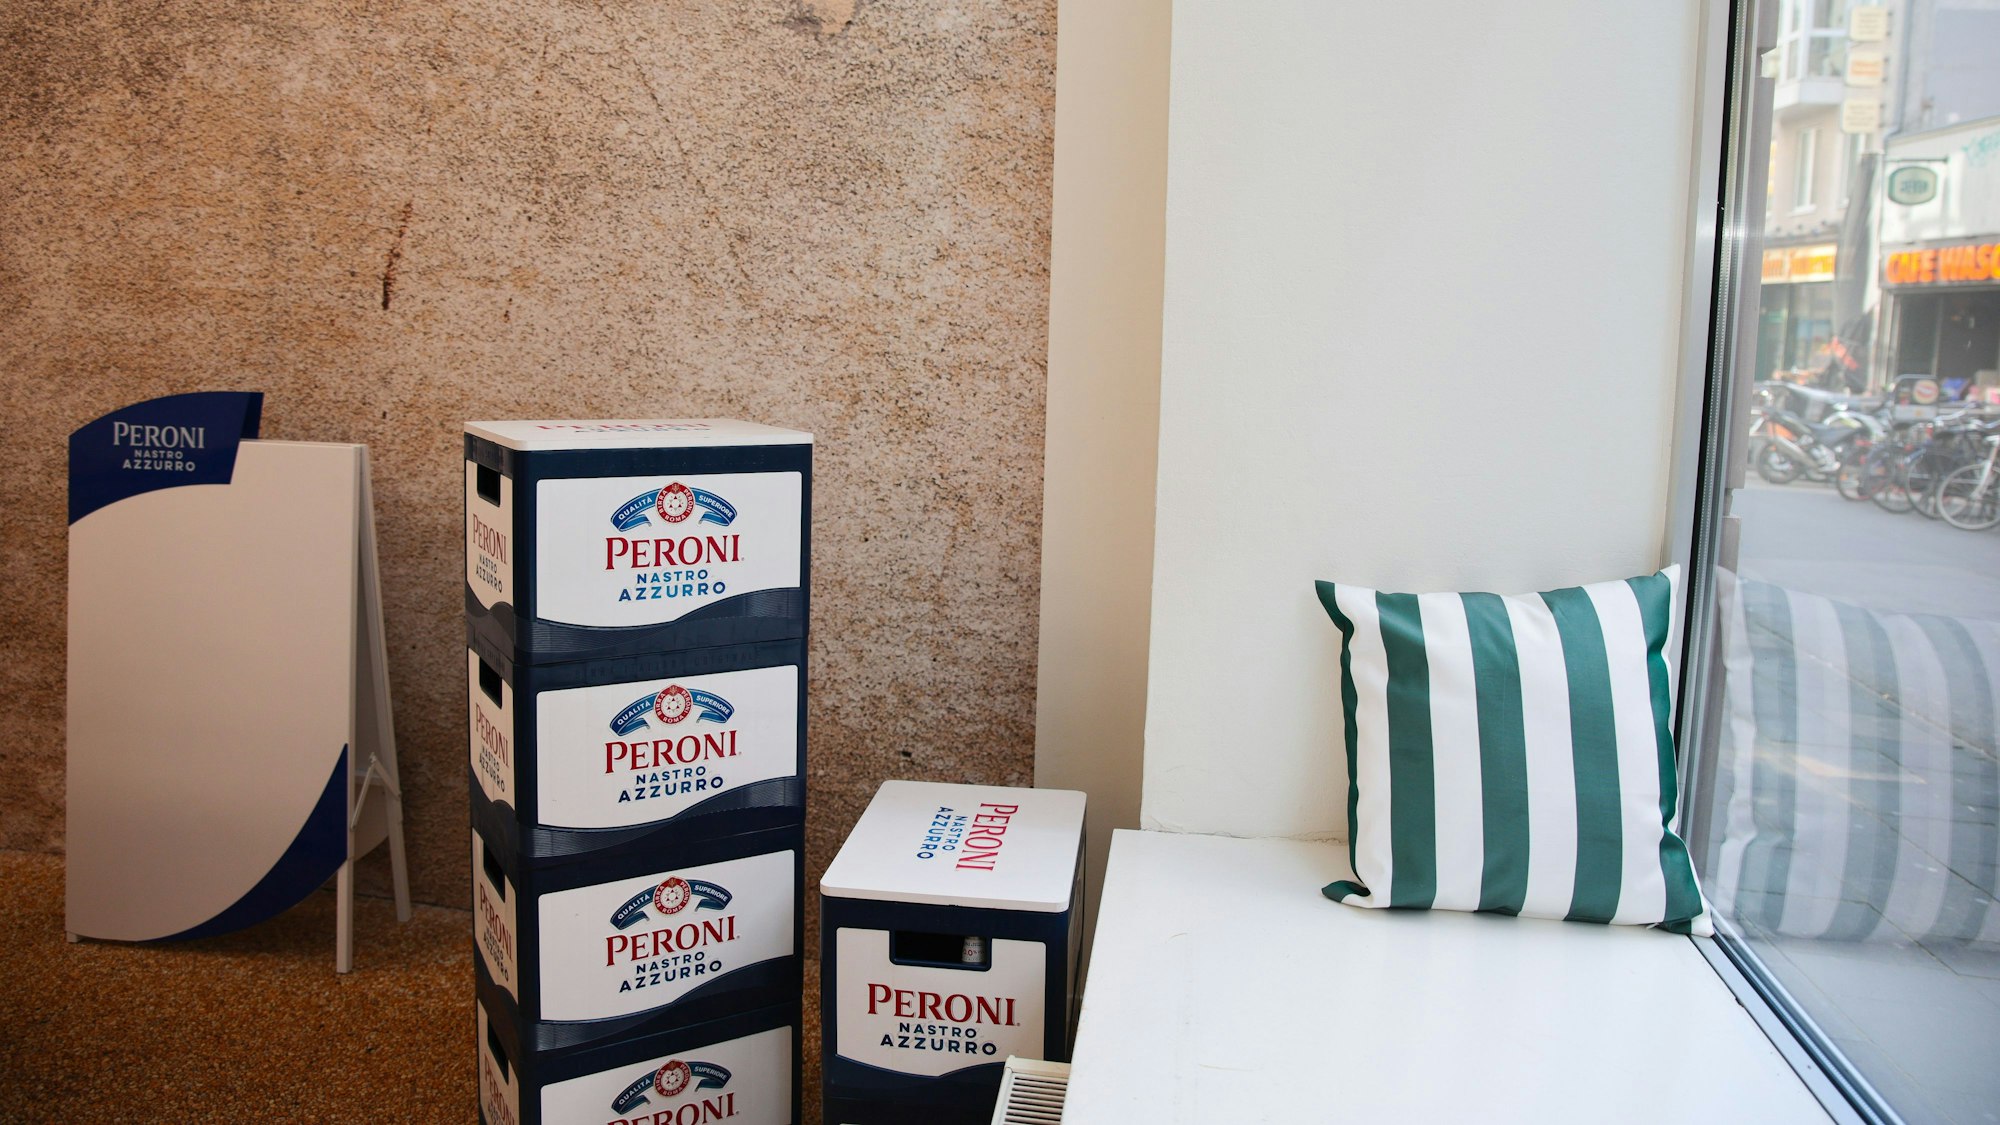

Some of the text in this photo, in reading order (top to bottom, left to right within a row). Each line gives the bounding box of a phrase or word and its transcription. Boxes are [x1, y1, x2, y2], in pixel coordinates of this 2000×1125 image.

[113, 421, 205, 448] PERONI
[122, 459, 196, 472] AZZURRO
[134, 449, 183, 459] NASTRO
[618, 494, 733, 520] QUALITÀ SUPERIORE
[473, 513, 507, 565] PERONI
[605, 534, 740, 570] PERONI
[476, 563, 503, 593] AZZURRO
[618, 581, 726, 601] AZZURRO
[637, 569, 708, 584] NASTRO
[617, 694, 730, 725] QUALITÀ SUPERIORE
[476, 702, 509, 768] PERONI
[605, 730, 737, 774] PERONI
[618, 776, 723, 803] AZZURRO
[636, 766, 706, 785] NASTRO
[917, 806, 954, 859] AZZURRO
[942, 815, 968, 851] NASTRO
[956, 803, 1019, 871] PERONI
[694, 884, 728, 902] SUPERIORE
[480, 882, 513, 963] PERONI
[606, 915, 735, 967] PERONI
[619, 960, 722, 993] AZZURRO
[636, 951, 705, 974] NASTRO
[867, 983, 1016, 1026] PERONI
[880, 1034, 997, 1056] AZZURRO
[899, 1022, 977, 1038] NASTRO
[694, 1065, 727, 1080] SUPERIORE
[607, 1092, 734, 1125] RONI
